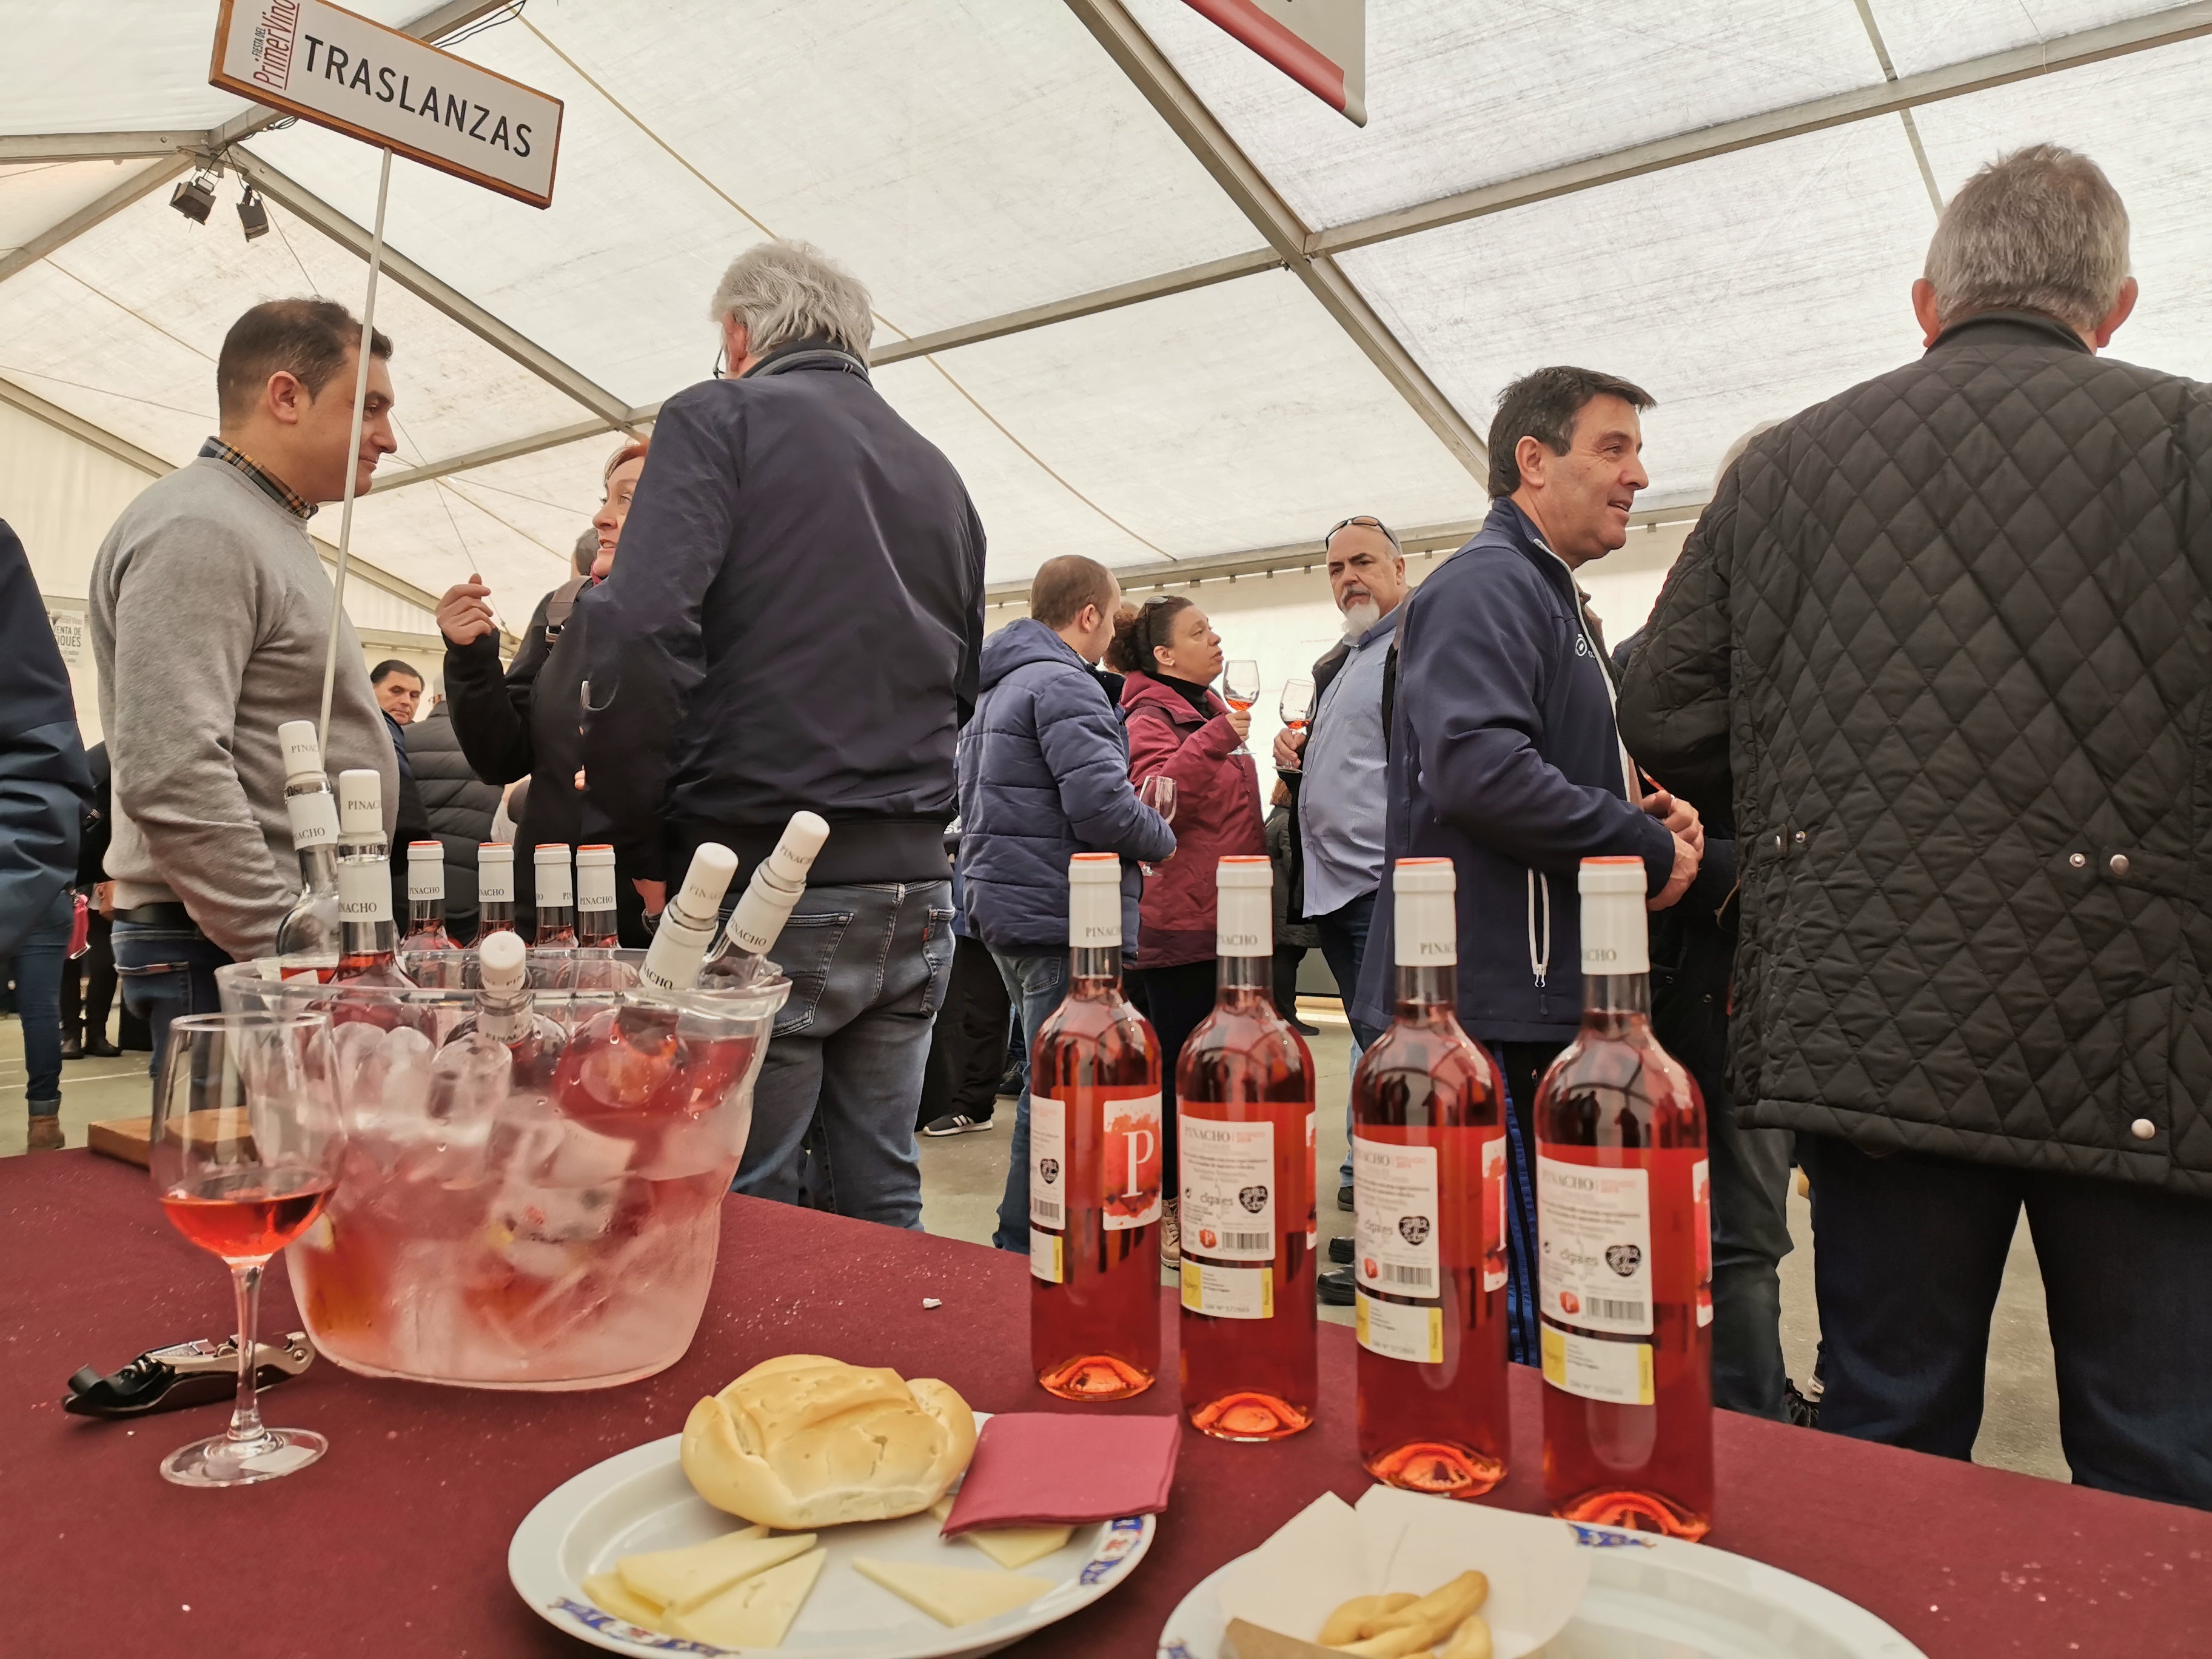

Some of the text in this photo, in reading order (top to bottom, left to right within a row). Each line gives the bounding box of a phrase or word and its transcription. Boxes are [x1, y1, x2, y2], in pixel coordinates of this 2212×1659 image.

[252, 27, 266, 58] FIESTA DEL
[304, 35, 532, 157] TRASLANZAS
[74, 627, 82, 635] DE
[580, 896, 613, 905] PINACHO
[1121, 1130, 1155, 1198] P
